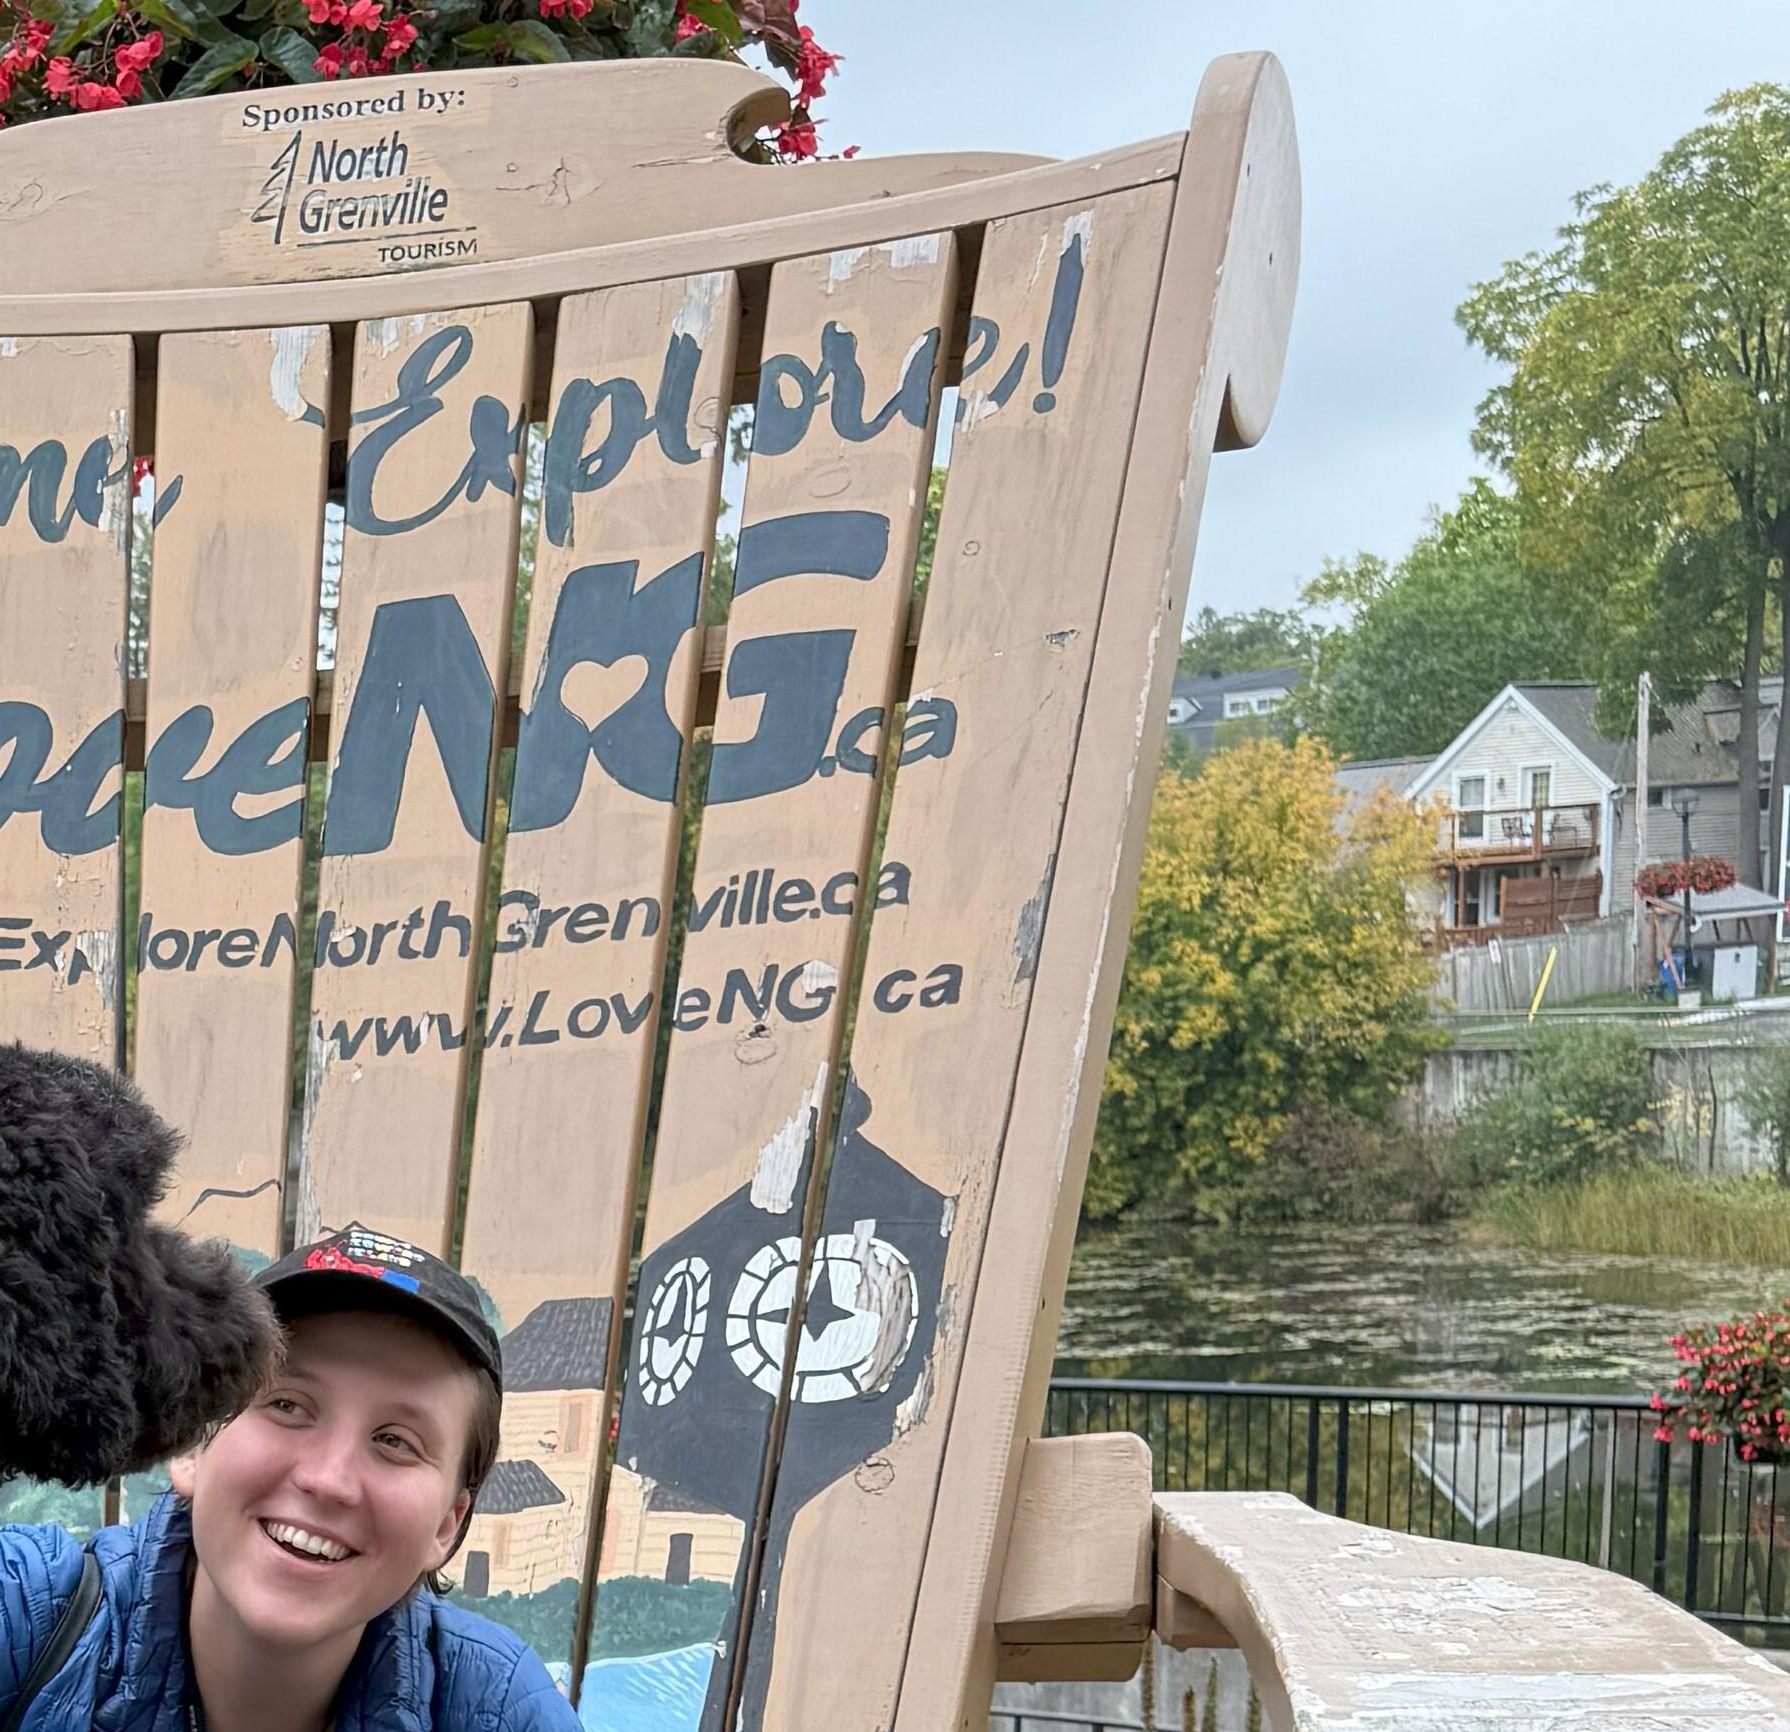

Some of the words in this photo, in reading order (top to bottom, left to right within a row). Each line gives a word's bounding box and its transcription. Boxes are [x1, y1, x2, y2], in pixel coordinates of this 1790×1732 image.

[242, 90, 405, 131] Sponsored
[417, 88, 465, 114] by:
[307, 130, 409, 184] North
[299, 176, 449, 233] Grenville
[378, 238, 477, 262] TOURISM
